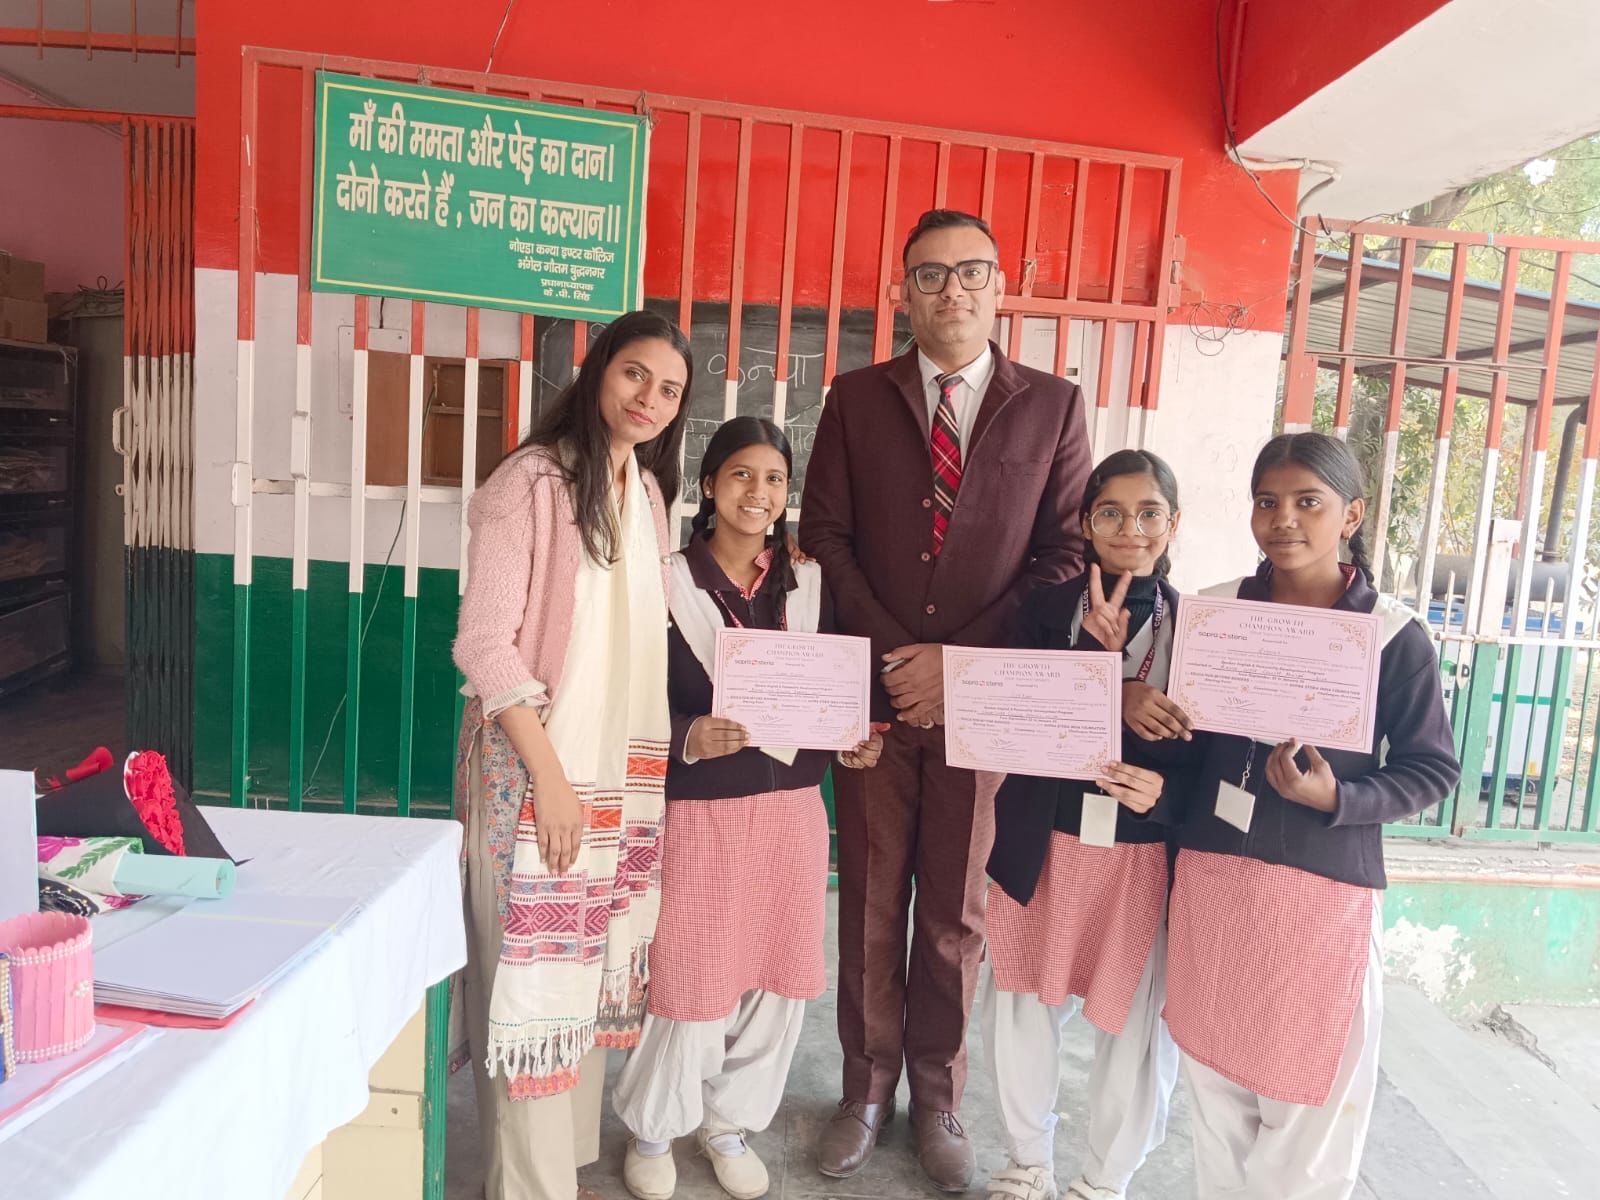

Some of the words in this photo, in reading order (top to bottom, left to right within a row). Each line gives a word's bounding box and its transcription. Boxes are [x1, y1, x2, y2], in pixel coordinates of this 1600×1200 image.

[349, 98, 377, 152] माँ
[378, 102, 406, 156] की
[409, 120, 465, 163] ममता
[467, 113, 506, 169] और
[508, 119, 537, 186] पेड़
[540, 138, 568, 177] का
[336, 160, 380, 215] दोनो
[384, 169, 432, 221] करते
[469, 190, 506, 230] जन
[509, 195, 537, 234] का
[509, 238, 535, 255] नोएडा
[536, 243, 560, 257] कन्या
